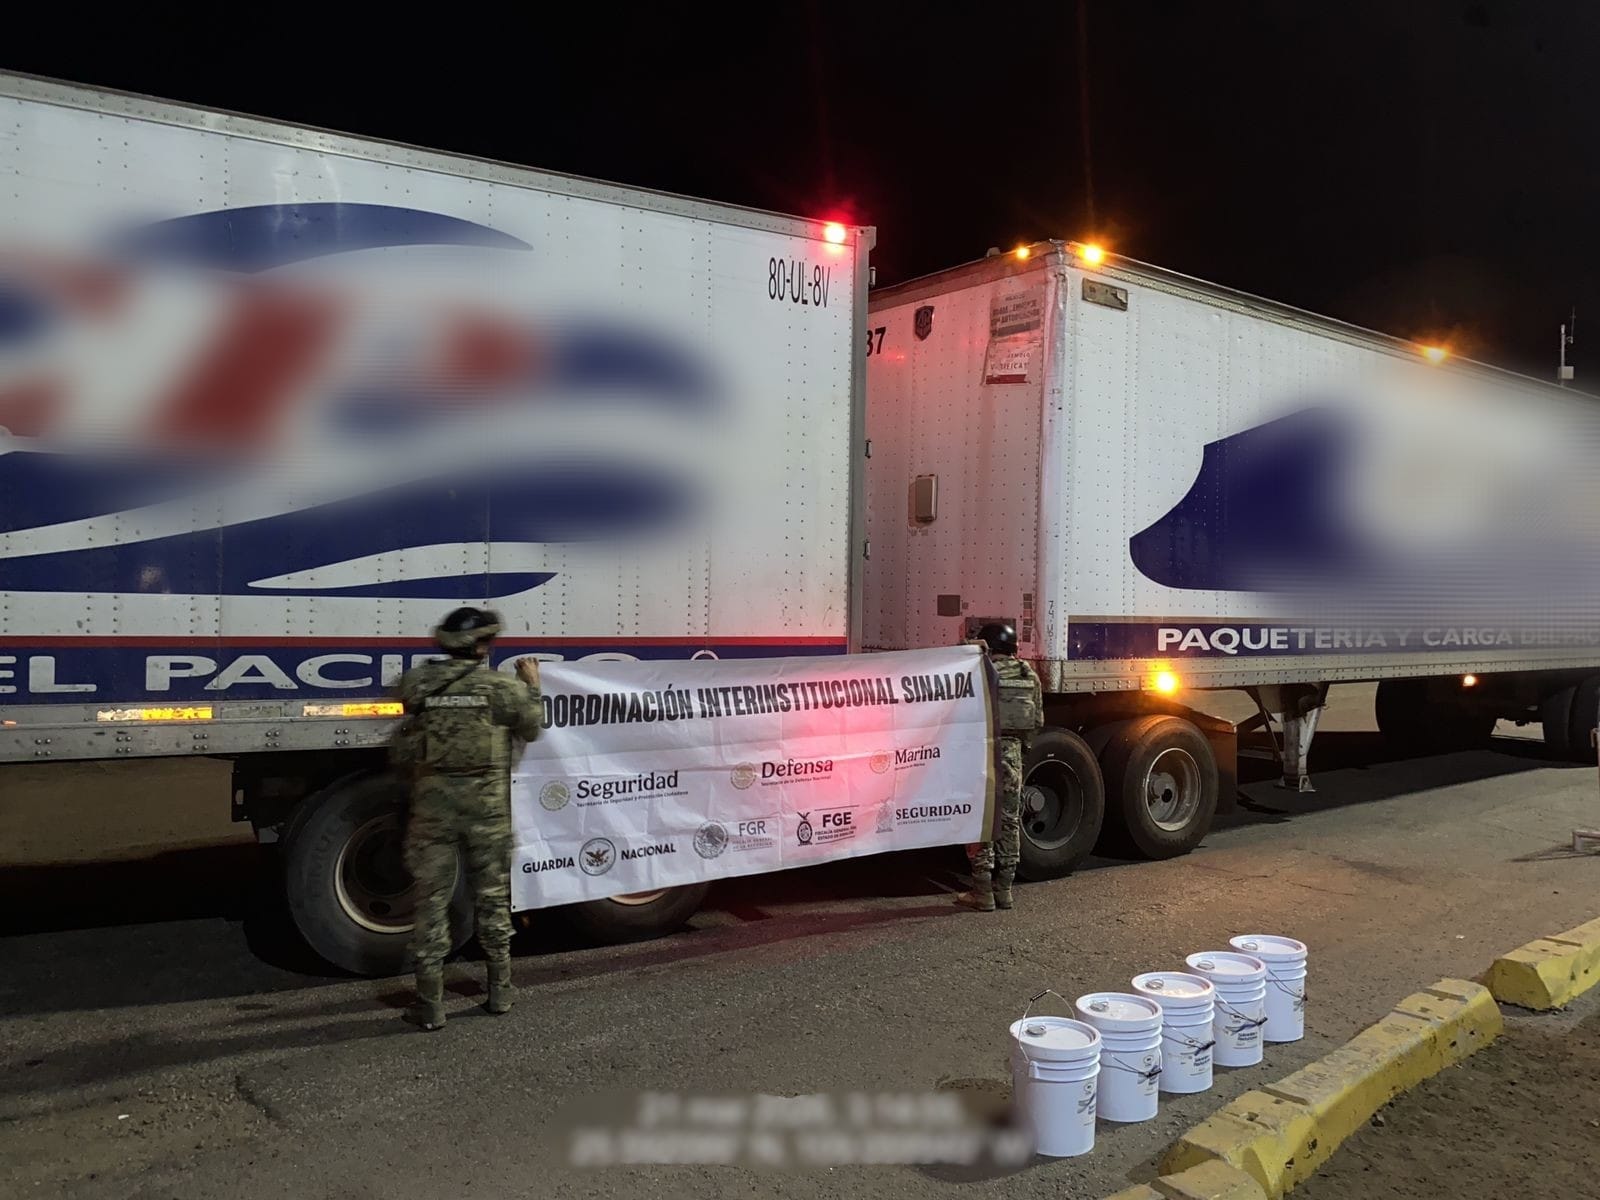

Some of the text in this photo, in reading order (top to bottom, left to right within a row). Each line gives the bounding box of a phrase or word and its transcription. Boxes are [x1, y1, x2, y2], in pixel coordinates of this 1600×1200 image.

[768, 256, 831, 308] 80-UL-8V
[1157, 628, 1388, 655] PAQUETERIA
[1394, 628, 1411, 647] Y
[1422, 627, 1513, 647] CARGA
[541, 672, 975, 729] OORDINACIÓN INTERINSTITUCIONAL SINALOA
[895, 745, 941, 765] Marina
[761, 758, 834, 778] Defensa
[576, 770, 679, 800] Seguridad
[822, 812, 852, 827] FGE
[896, 804, 971, 820] SEGURIDAD
[738, 821, 766, 836] FGR
[522, 843, 676, 873] GUARDIA NACIONAL
